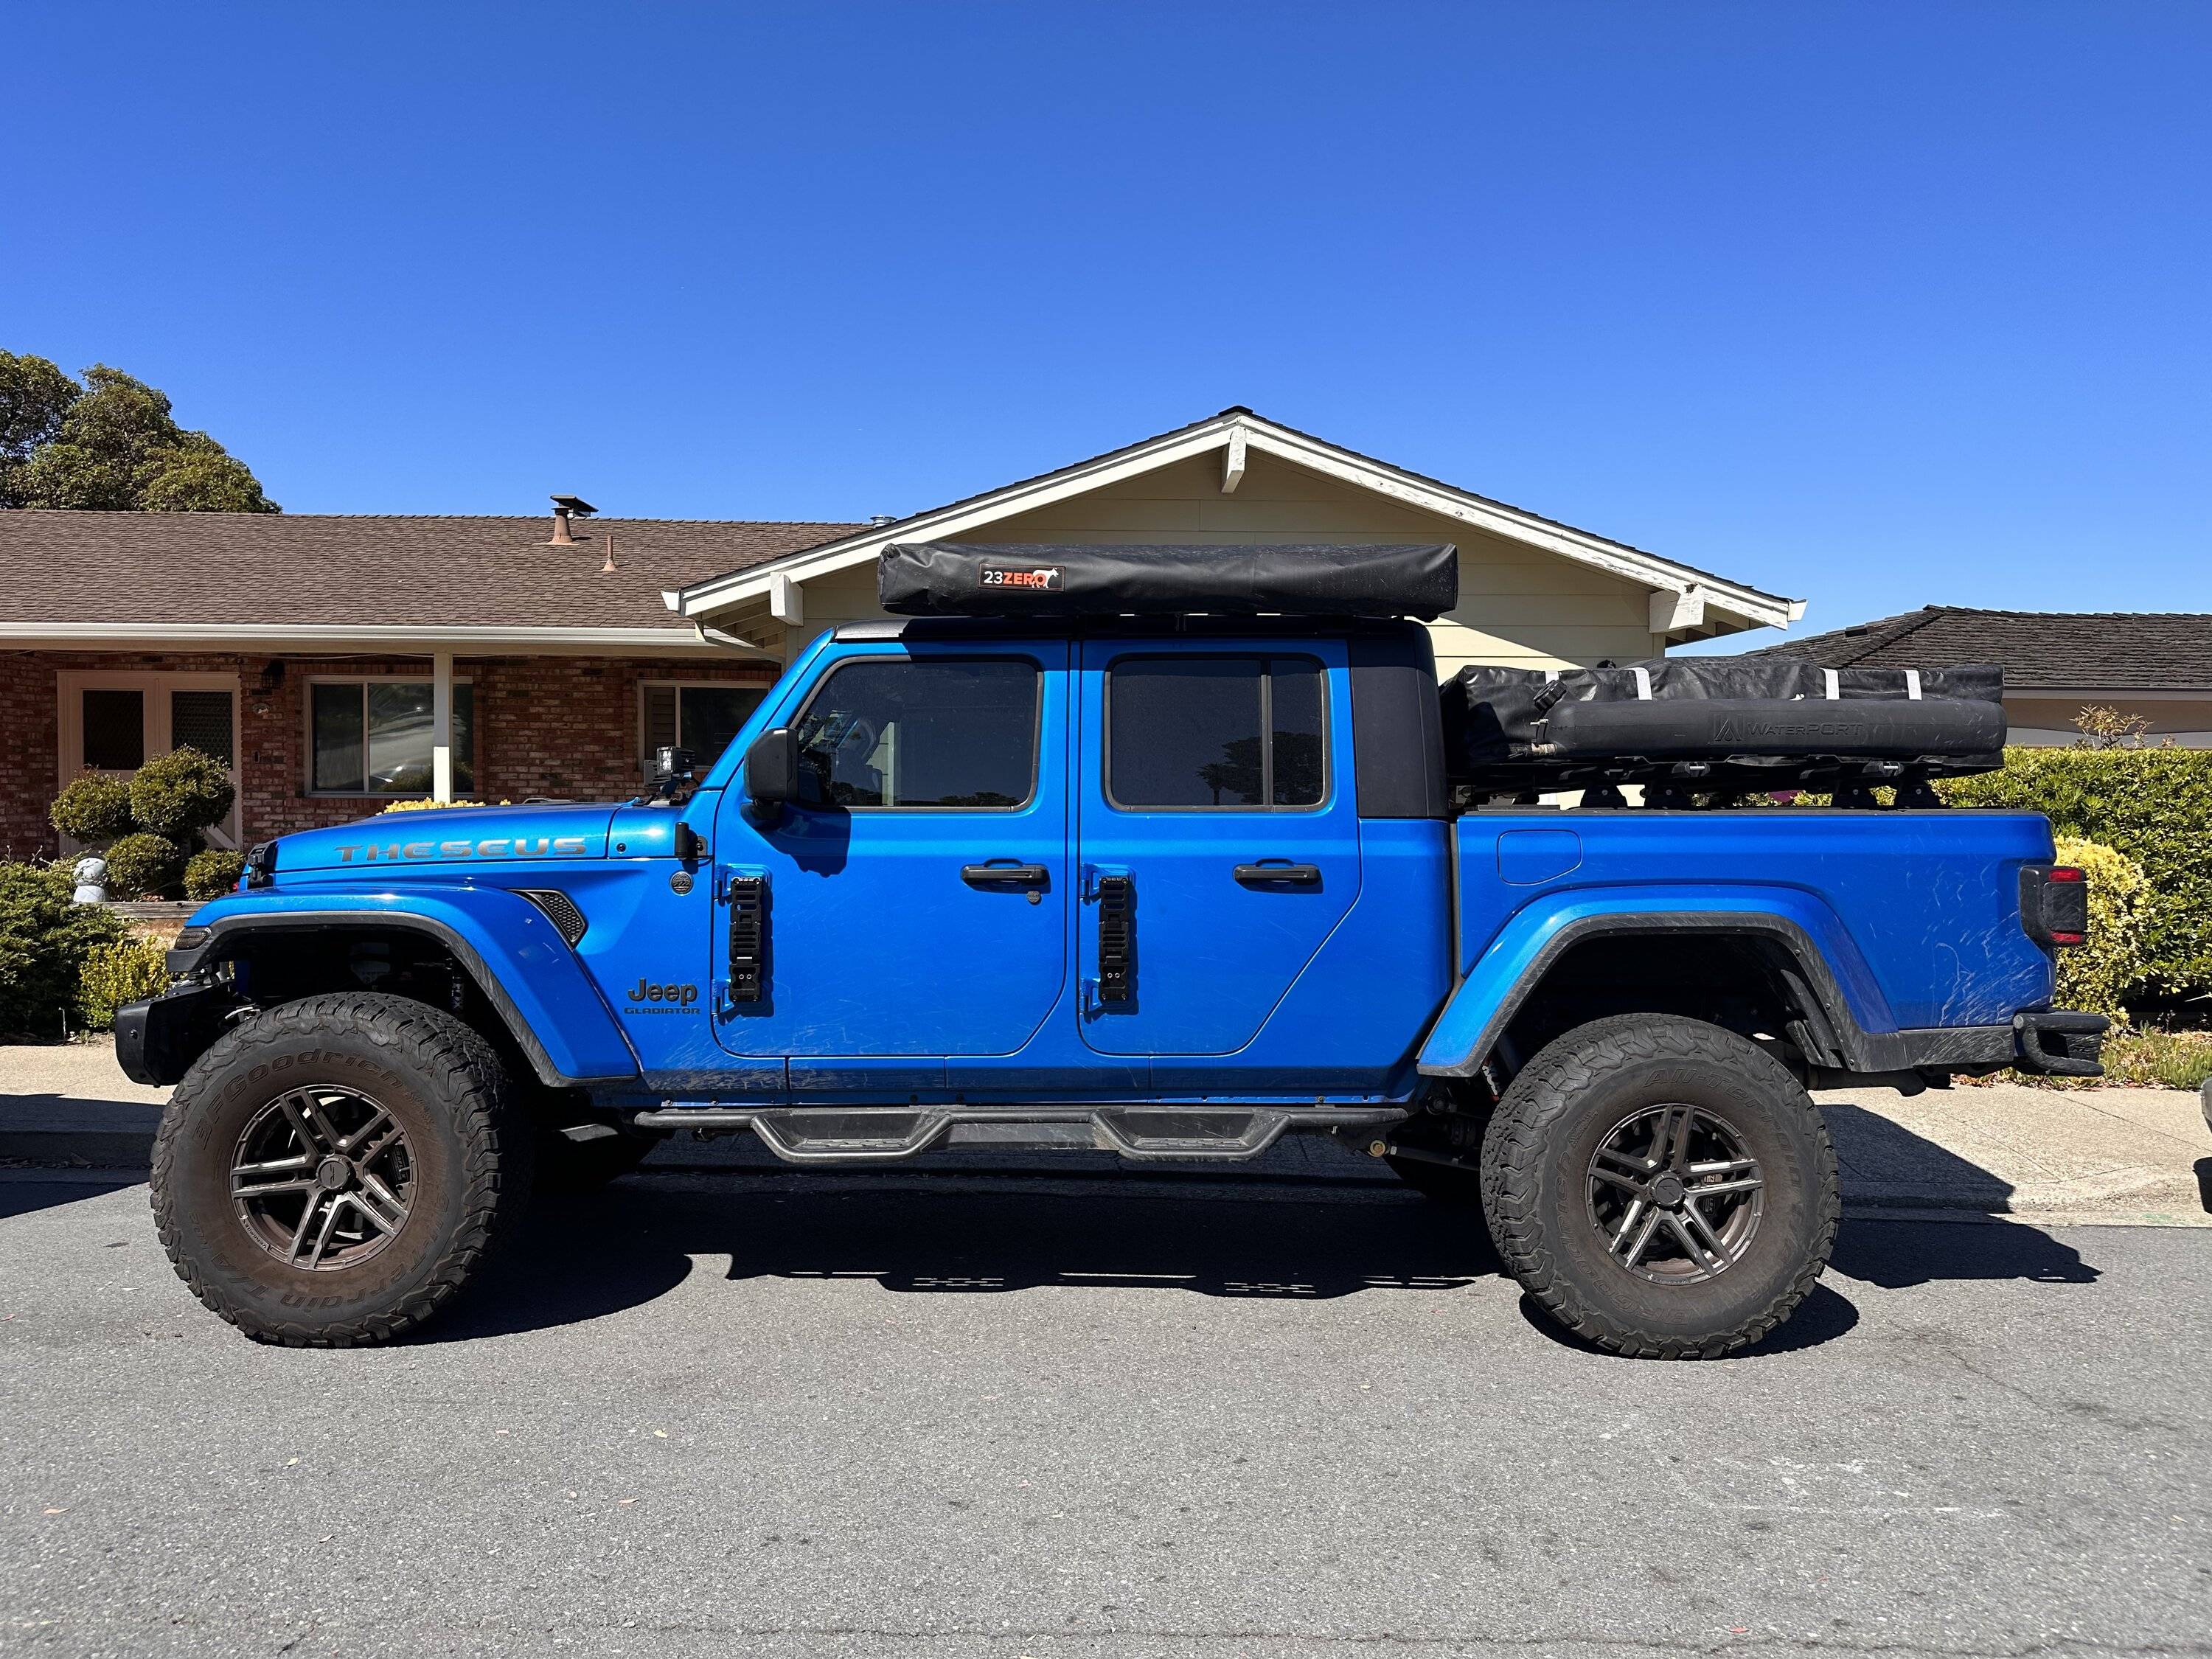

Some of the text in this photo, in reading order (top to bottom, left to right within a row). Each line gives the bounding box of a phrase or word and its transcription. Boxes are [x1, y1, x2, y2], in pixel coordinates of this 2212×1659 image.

[984, 571, 1046, 586] 23ZERO
[333, 838, 588, 862] THESEUS
[627, 978, 698, 1006] Jeep
[624, 1007, 700, 1015] GLADIATOR
[192, 1048, 404, 1151] BFGoodrich
